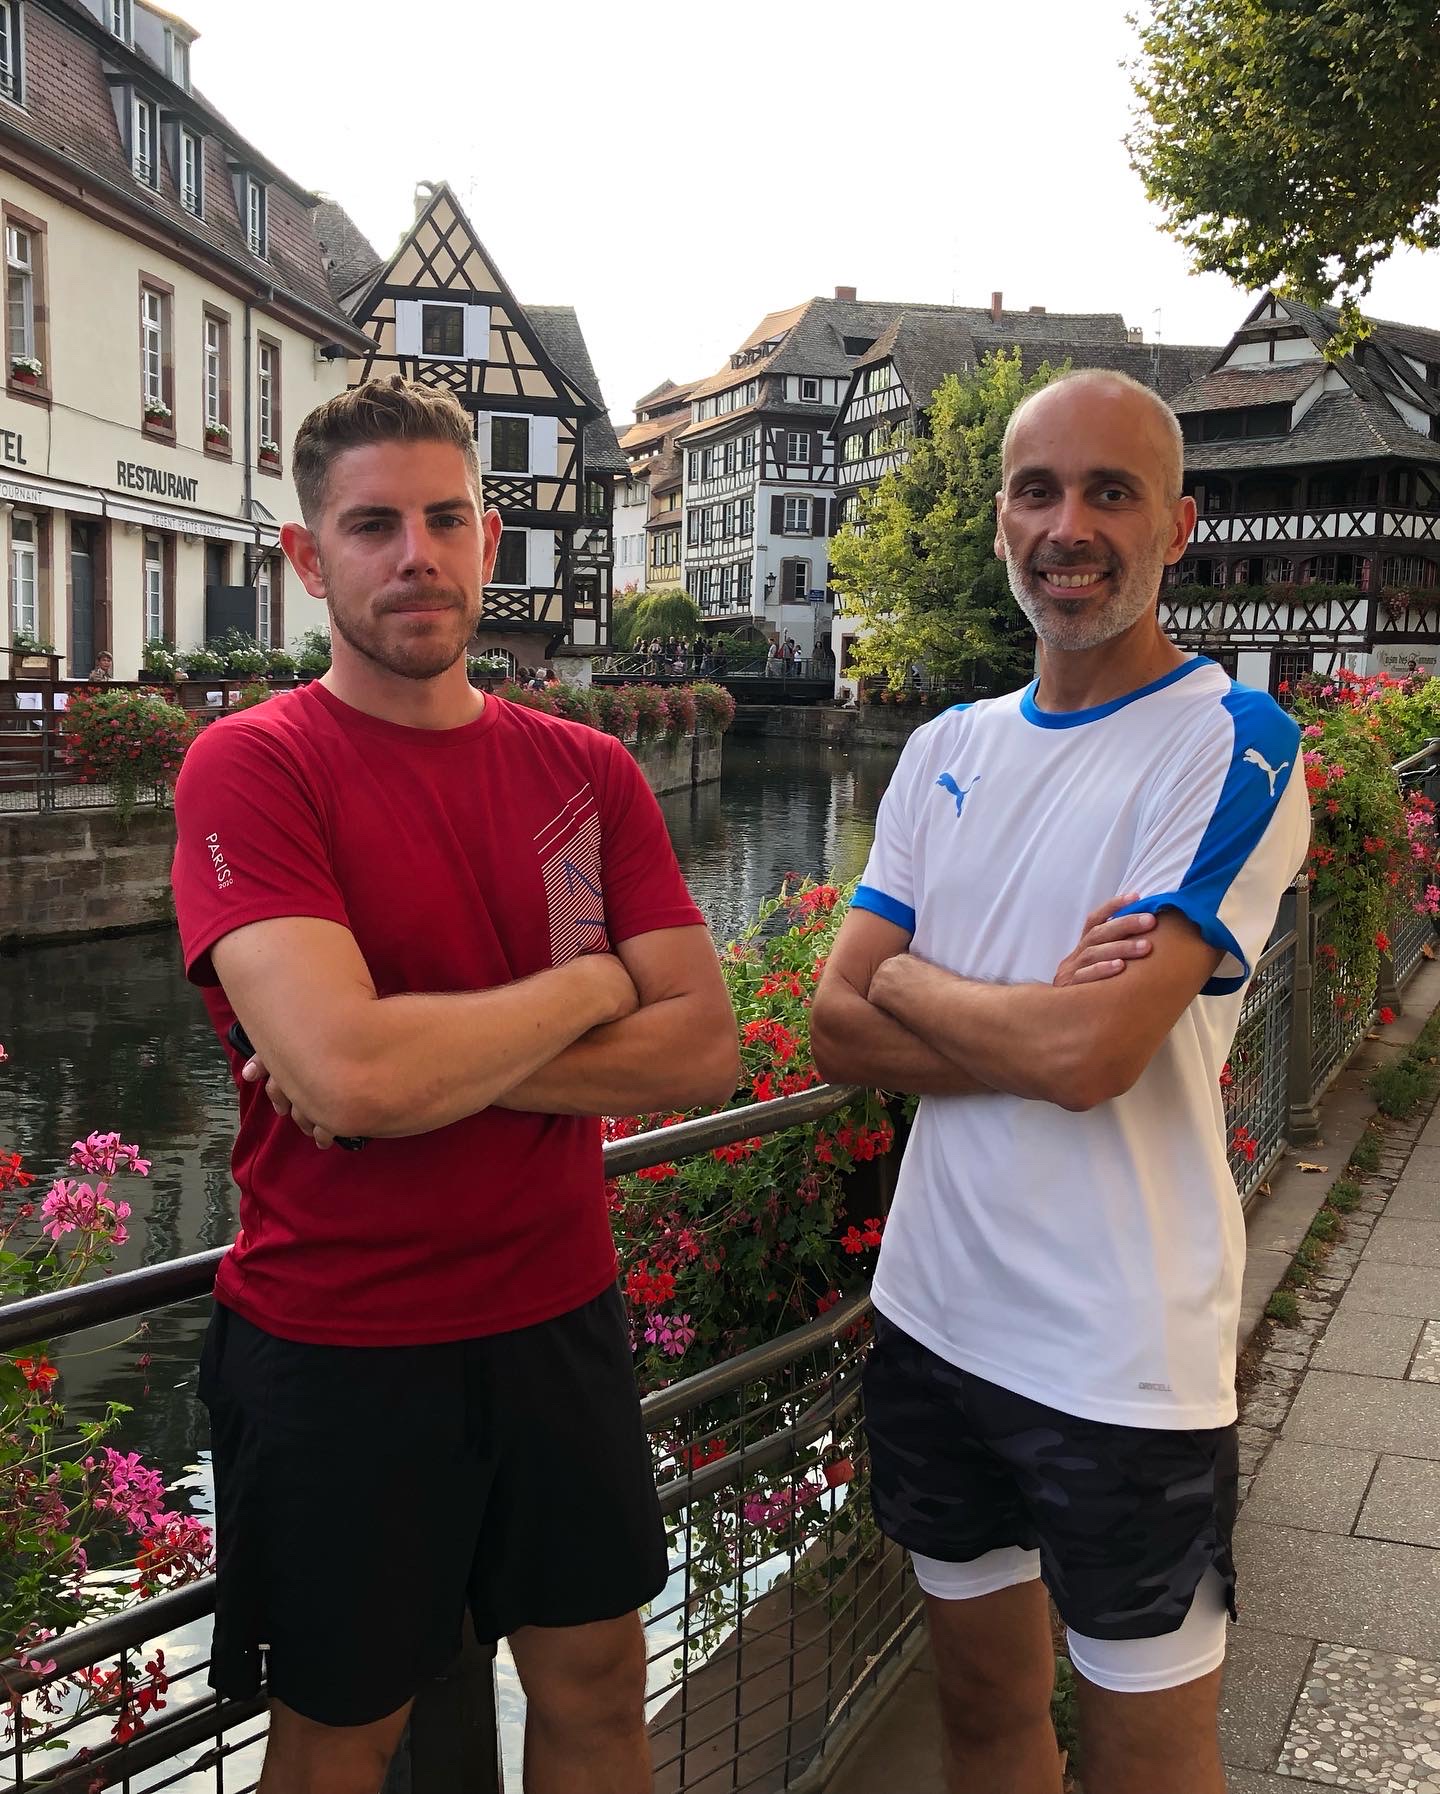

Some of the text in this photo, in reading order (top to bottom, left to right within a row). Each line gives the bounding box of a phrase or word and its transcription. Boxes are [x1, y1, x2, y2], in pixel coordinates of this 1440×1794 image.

[0, 483, 42, 503] OURNANT
[117, 460, 199, 502] RESTAURANT
[152, 514, 176, 529] REGENT
[178, 519, 198, 533] PETITE
[205, 832, 231, 882] PARIS
